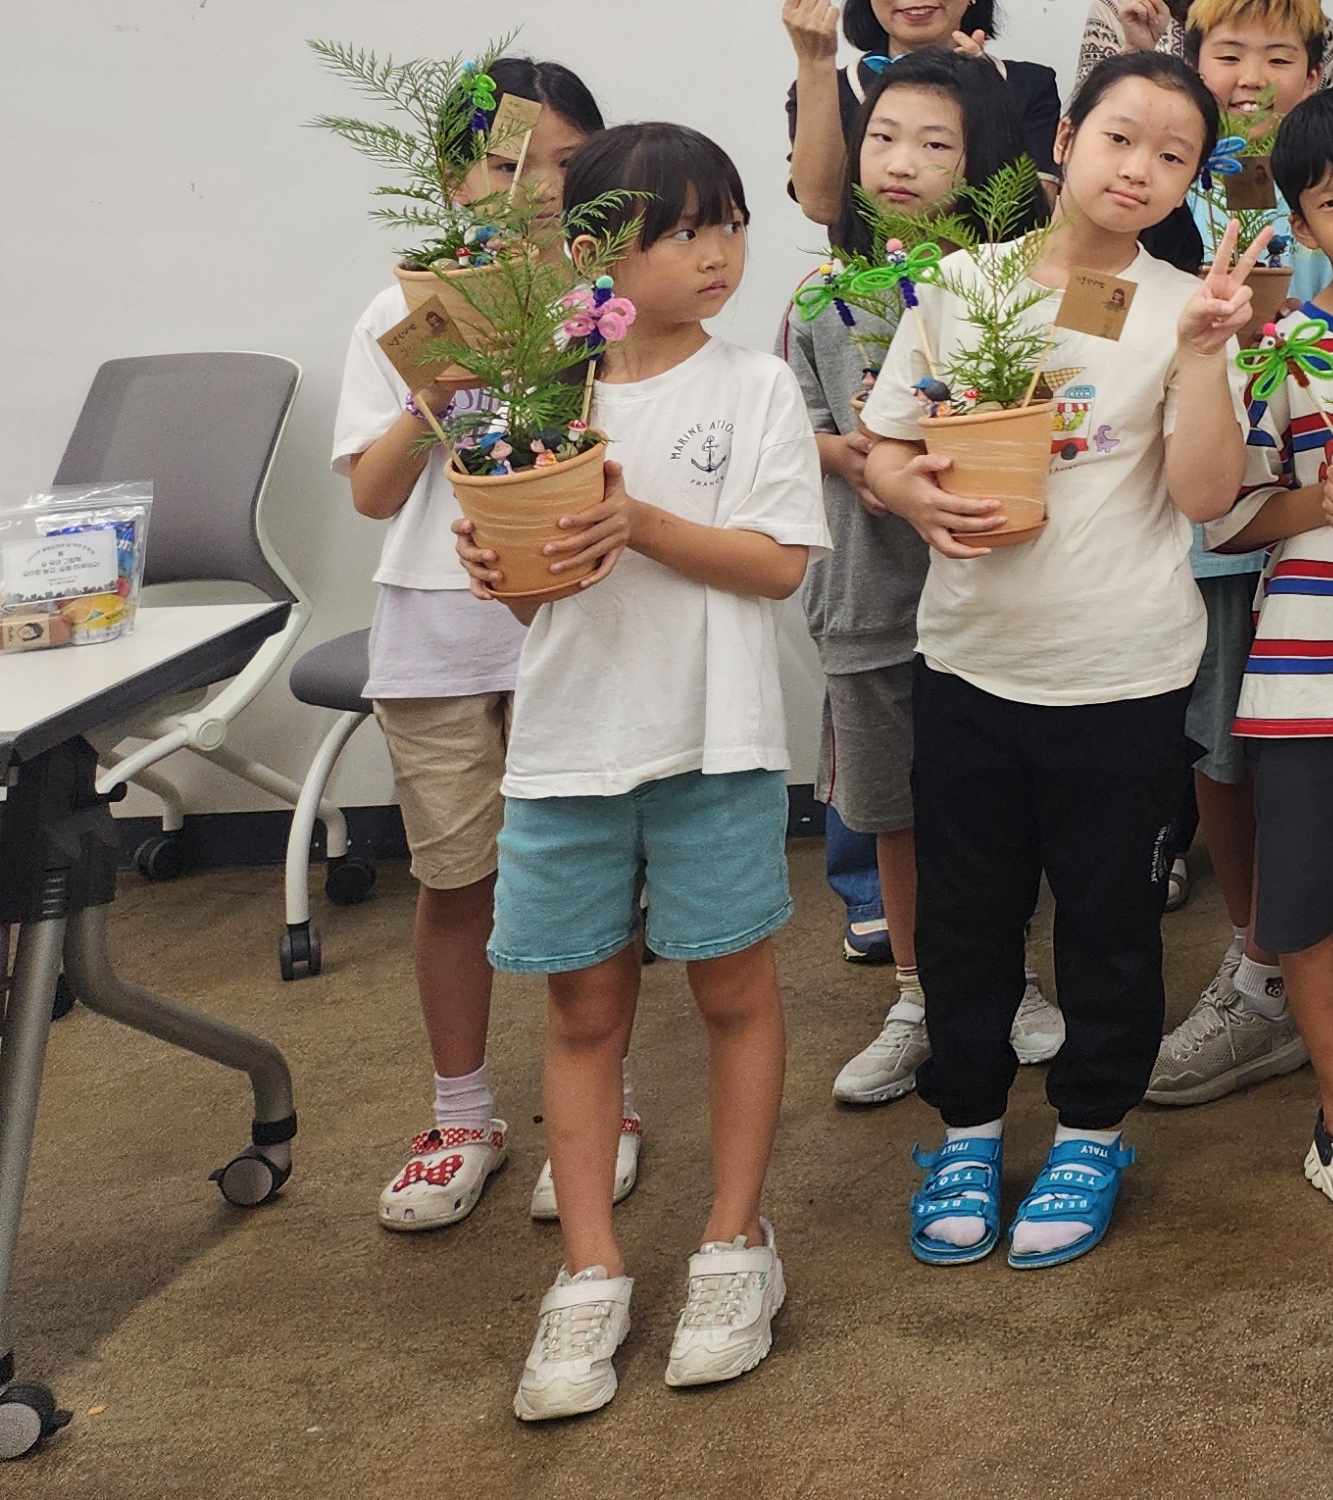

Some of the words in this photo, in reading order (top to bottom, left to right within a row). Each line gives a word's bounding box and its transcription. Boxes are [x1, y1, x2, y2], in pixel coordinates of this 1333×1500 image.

[670, 423, 704, 460] MARINE
[1080, 1145, 1109, 1158] ITALY
[1049, 1171, 1095, 1185] TTON
[1042, 1199, 1088, 1211] BENE
